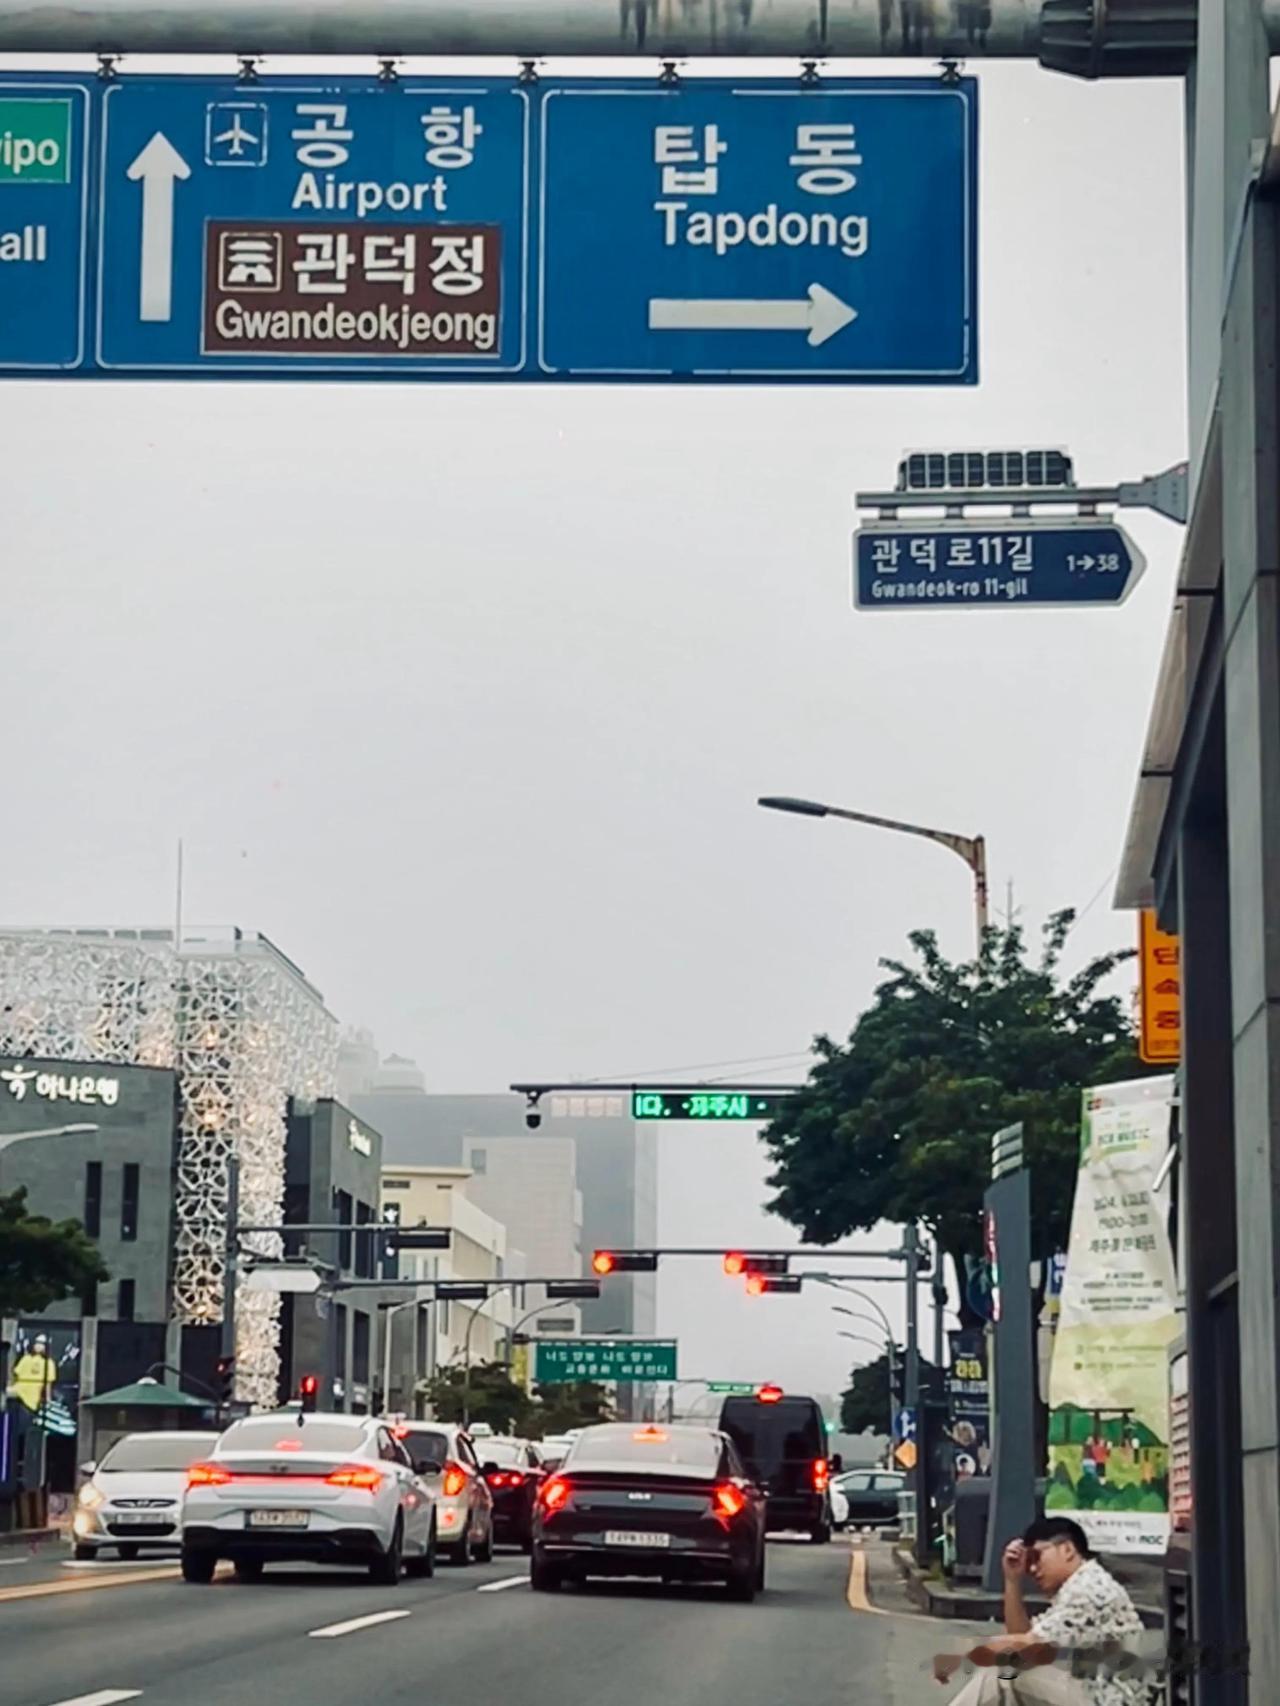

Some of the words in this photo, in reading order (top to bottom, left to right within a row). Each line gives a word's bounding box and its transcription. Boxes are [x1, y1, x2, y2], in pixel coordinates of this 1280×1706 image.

[0, 131, 60, 174] ipo
[292, 173, 448, 217] Airport
[654, 202, 869, 257] Tapdong
[293, 233, 485, 296] 관덕정
[215, 300, 496, 349] Gwandeokjeong
[871, 579, 980, 598] Gwandeok-ro
[984, 577, 1028, 599] 11-gil
